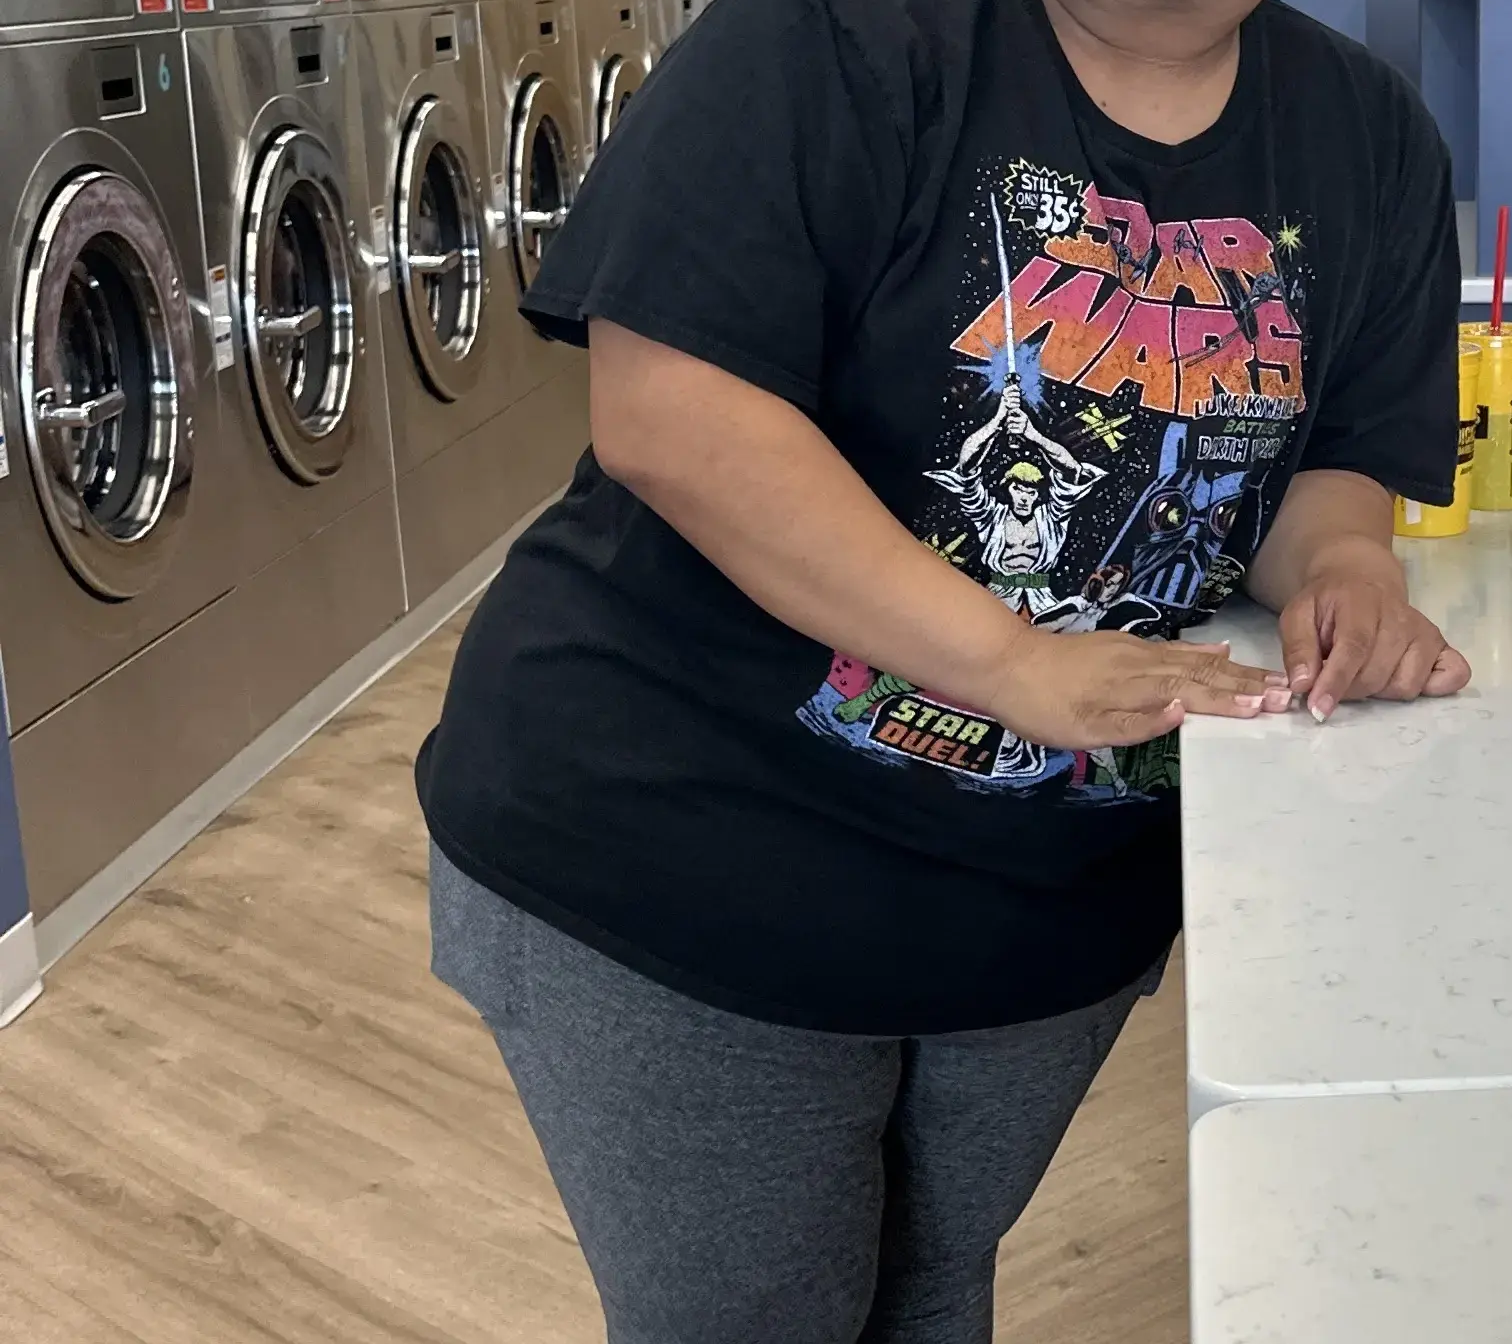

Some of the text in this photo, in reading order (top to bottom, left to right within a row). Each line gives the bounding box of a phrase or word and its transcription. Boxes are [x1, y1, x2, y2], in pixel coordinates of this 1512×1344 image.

[159, 53, 170, 92] 6
[1021, 173, 1064, 195] STILL
[1035, 193, 1079, 233] 35¢
[950, 254, 1306, 419] WARS
[889, 699, 990, 745] STAR
[876, 720, 990, 769] DUEL!
